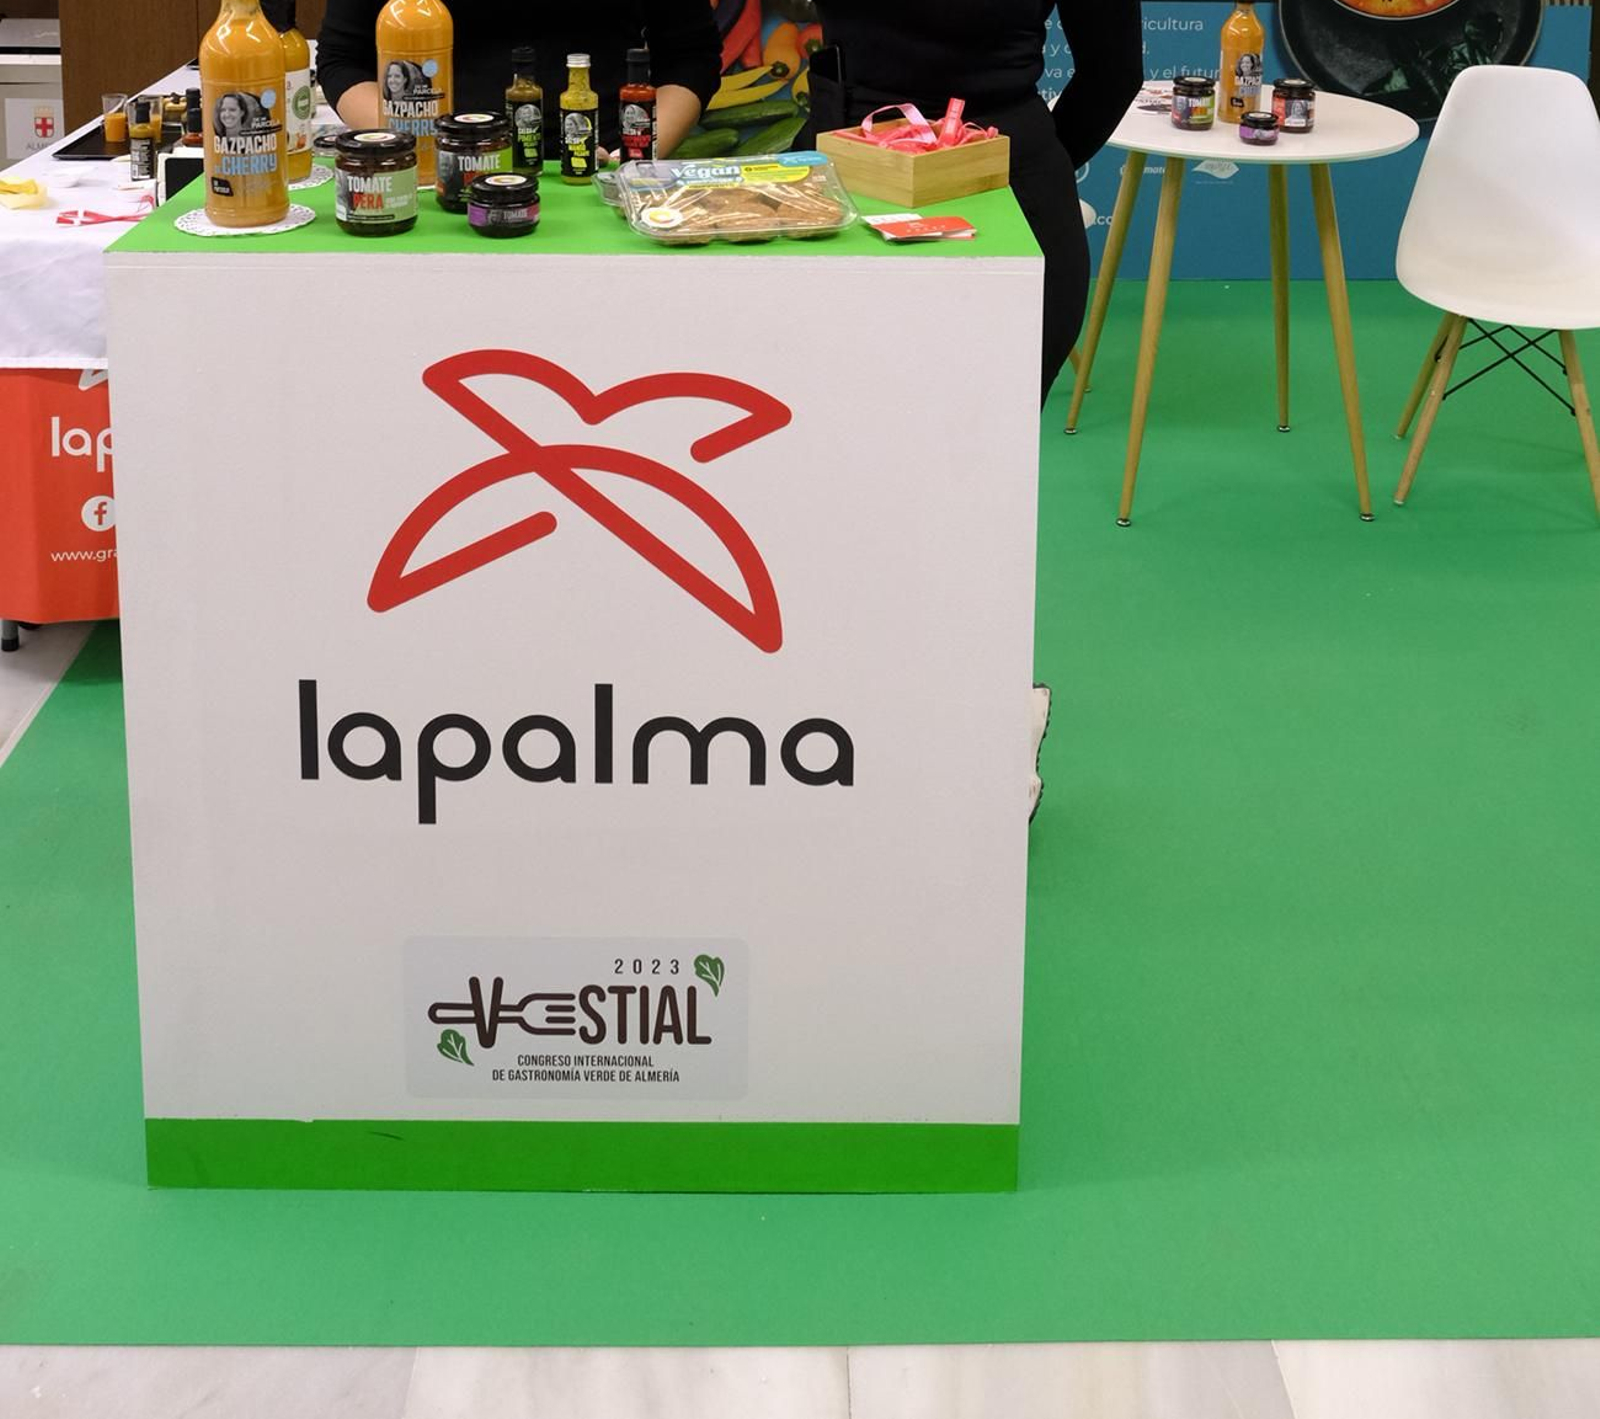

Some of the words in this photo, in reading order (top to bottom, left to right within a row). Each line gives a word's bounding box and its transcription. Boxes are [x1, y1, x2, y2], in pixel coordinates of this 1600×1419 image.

[382, 100, 439, 118] GAZPACHO
[213, 133, 278, 155] GAZPACHO
[222, 154, 278, 176] CHERRY
[457, 155, 501, 172] TOMATE
[346, 176, 393, 194] TOMATE
[353, 193, 384, 210] PERA
[299, 679, 854, 824] lapalma
[614, 958, 680, 975] 2023
[428, 976, 713, 1049] VESTIAL
[517, 1054, 571, 1067] CONGRESO
[574, 1054, 654, 1068] INTERNACIONAL
[492, 1069, 505, 1082] DE
[508, 1068, 581, 1082] GASTRONOMÍA
[583, 1069, 615, 1082] VERDE
[618, 1069, 632, 1082] DE
[634, 1068, 680, 1082] ALMERÍA
